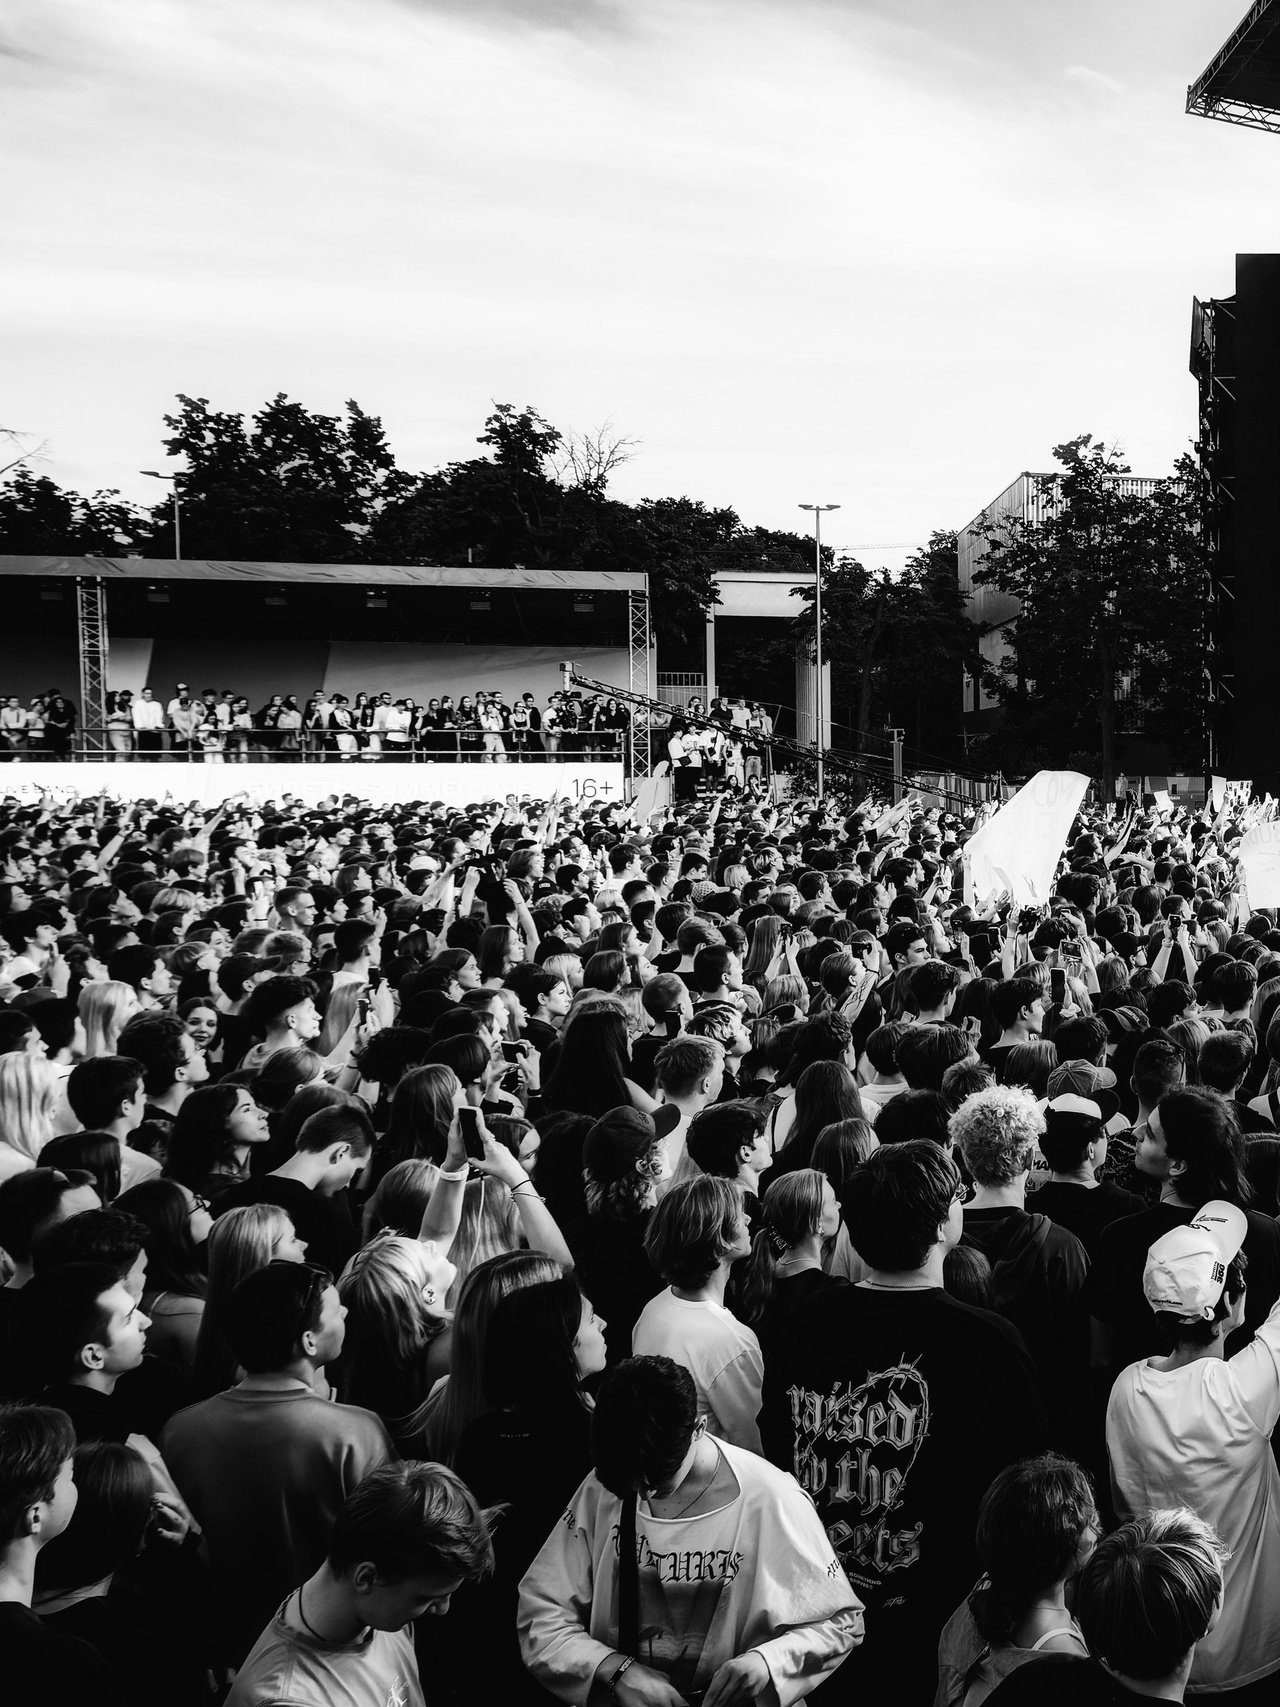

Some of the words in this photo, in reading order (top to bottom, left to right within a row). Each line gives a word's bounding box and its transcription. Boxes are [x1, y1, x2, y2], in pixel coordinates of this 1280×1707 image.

[572, 778, 613, 798] 16+
[785, 1381, 913, 1451] raised
[834, 1447, 906, 1516] the
